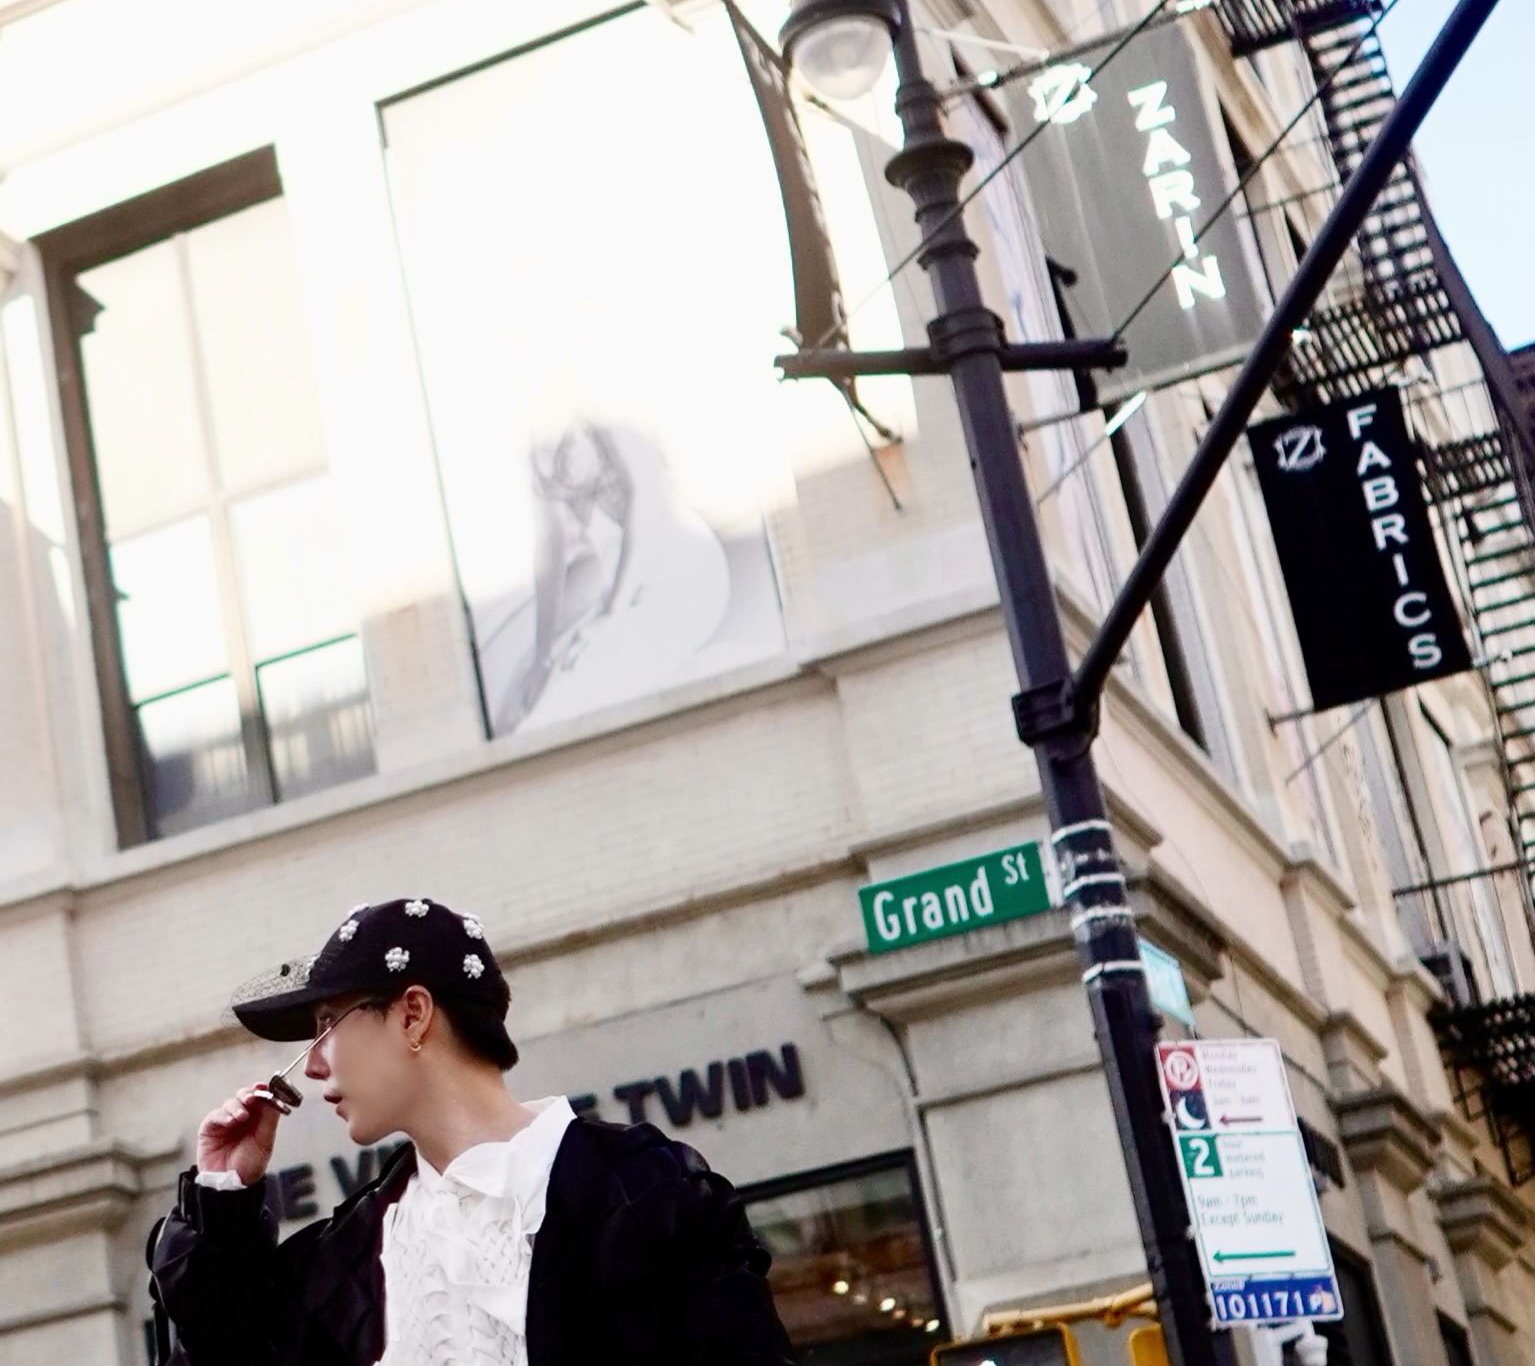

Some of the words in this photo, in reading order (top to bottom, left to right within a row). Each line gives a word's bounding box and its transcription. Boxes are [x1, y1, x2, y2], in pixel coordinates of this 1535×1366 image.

[1127, 80, 1226, 310] ZARIN
[1346, 403, 1443, 670] FABRICS
[873, 866, 995, 941] Grand
[1000, 851, 1030, 885] St
[612, 1041, 806, 1128] TWIN
[1188, 1137, 1215, 1176] 2
[1215, 1290, 1305, 1321] 101171
